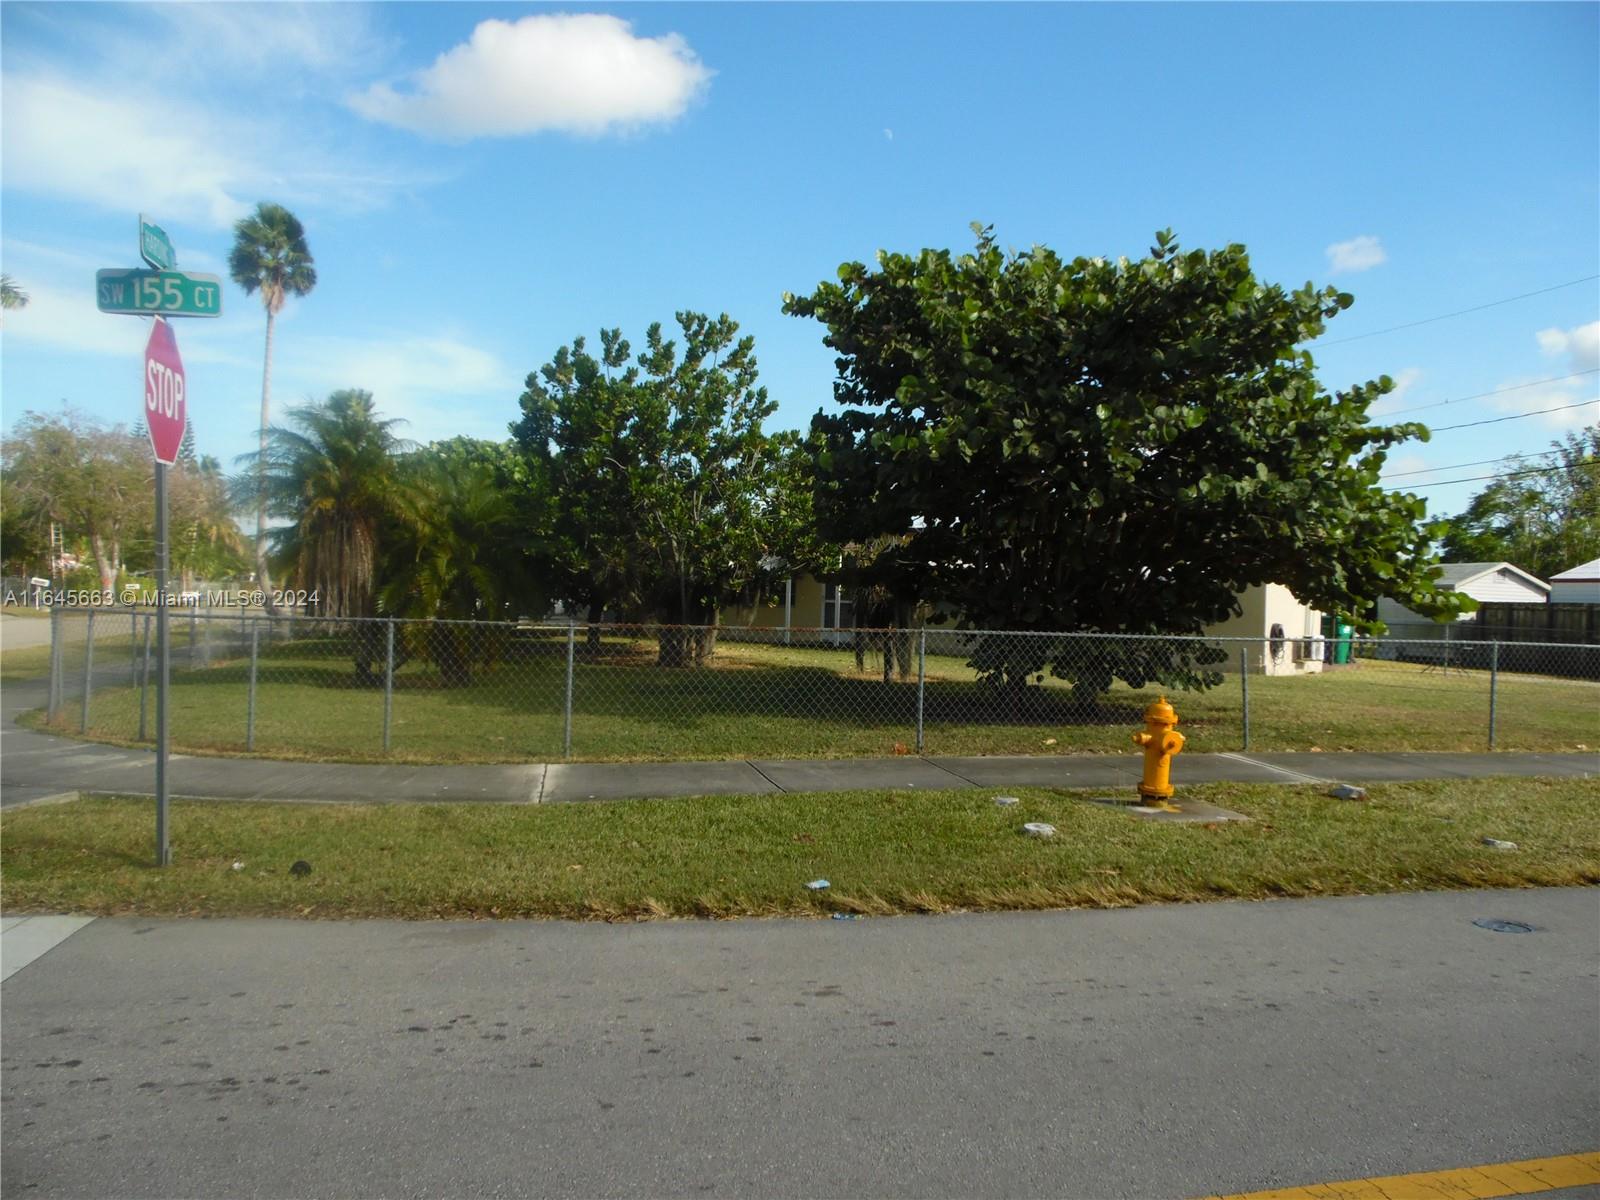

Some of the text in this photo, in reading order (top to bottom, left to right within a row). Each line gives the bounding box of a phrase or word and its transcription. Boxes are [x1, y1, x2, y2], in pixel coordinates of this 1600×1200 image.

[101, 277, 214, 309] SW 155 CT
[146, 359, 184, 420] STOP
